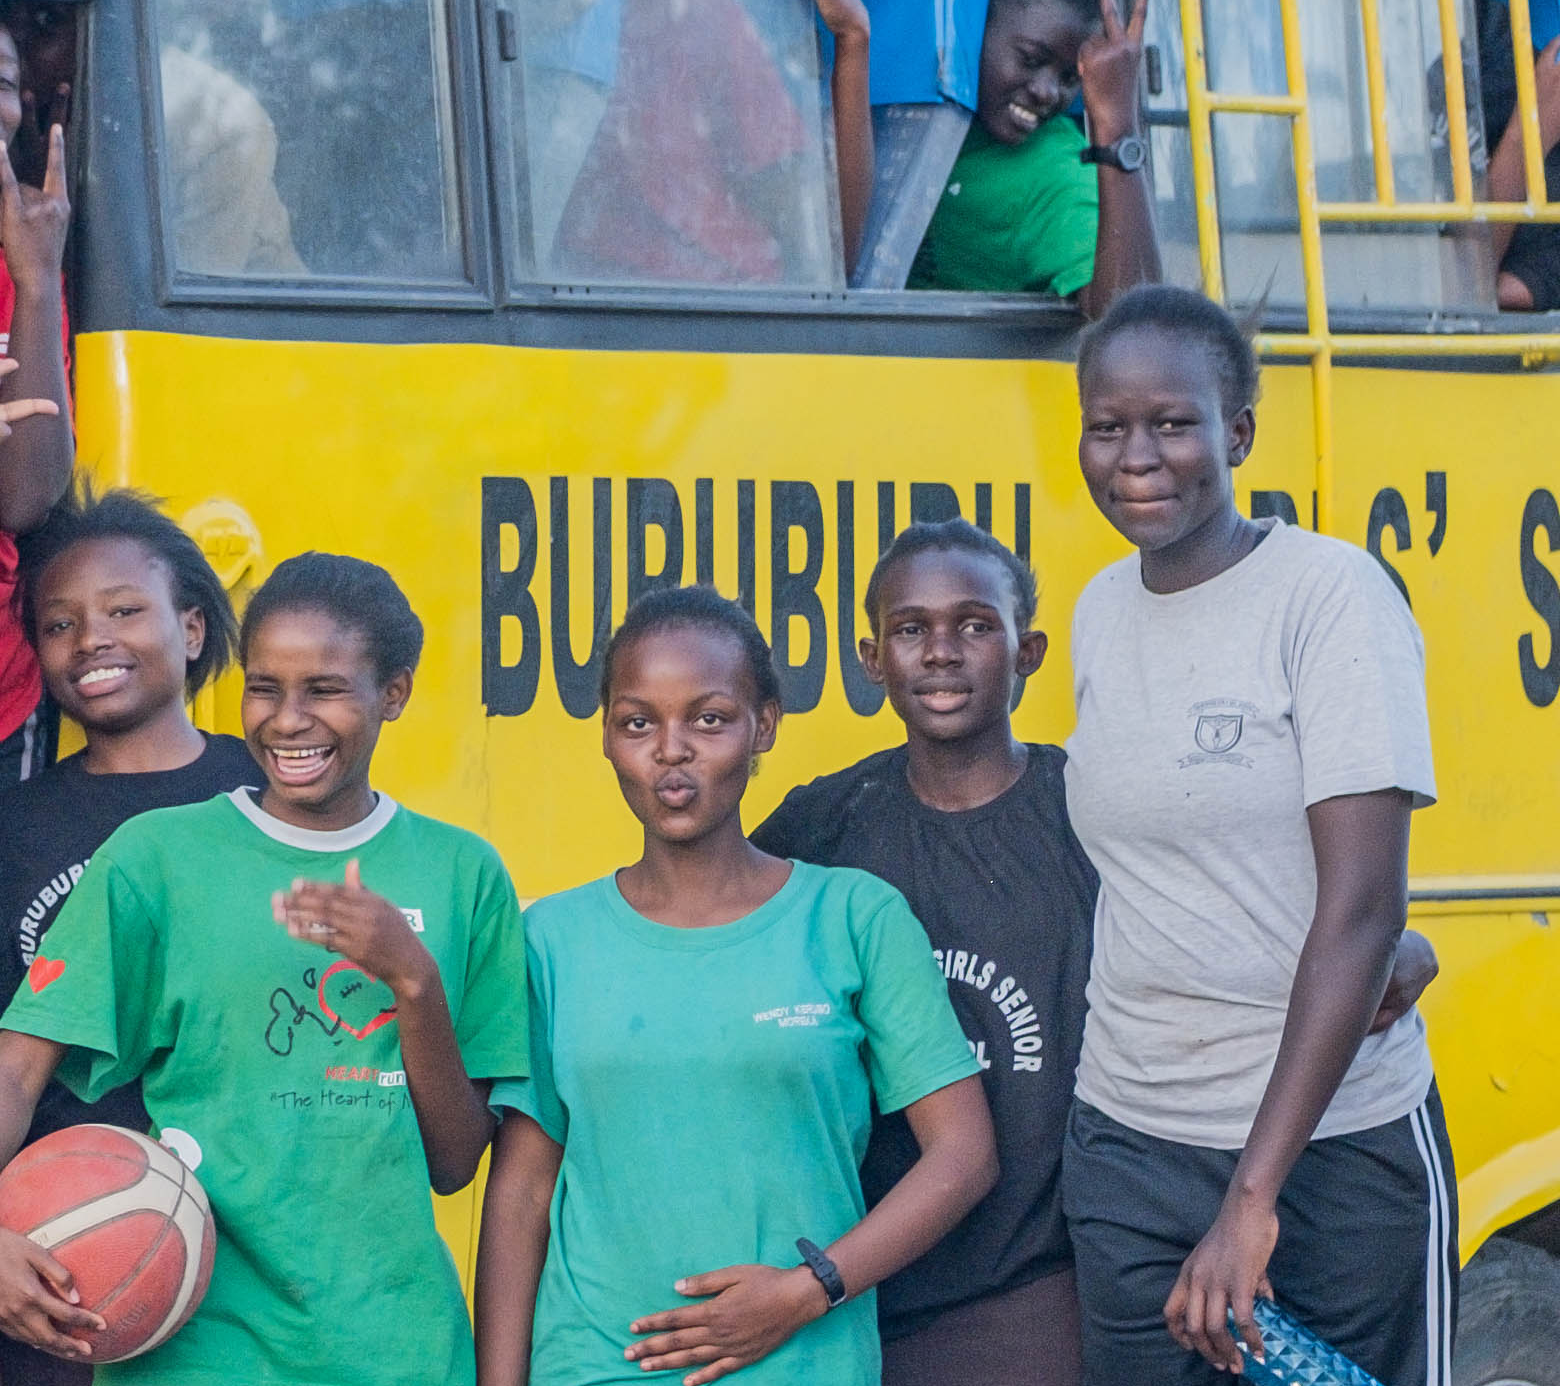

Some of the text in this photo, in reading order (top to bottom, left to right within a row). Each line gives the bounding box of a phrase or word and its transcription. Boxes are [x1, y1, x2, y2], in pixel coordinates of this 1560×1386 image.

[20, 859, 91, 966] BURUBUR
[990, 975, 1043, 1072] SENIOR
[321, 1088, 372, 1108] Heart
[378, 1092, 395, 1117] of
